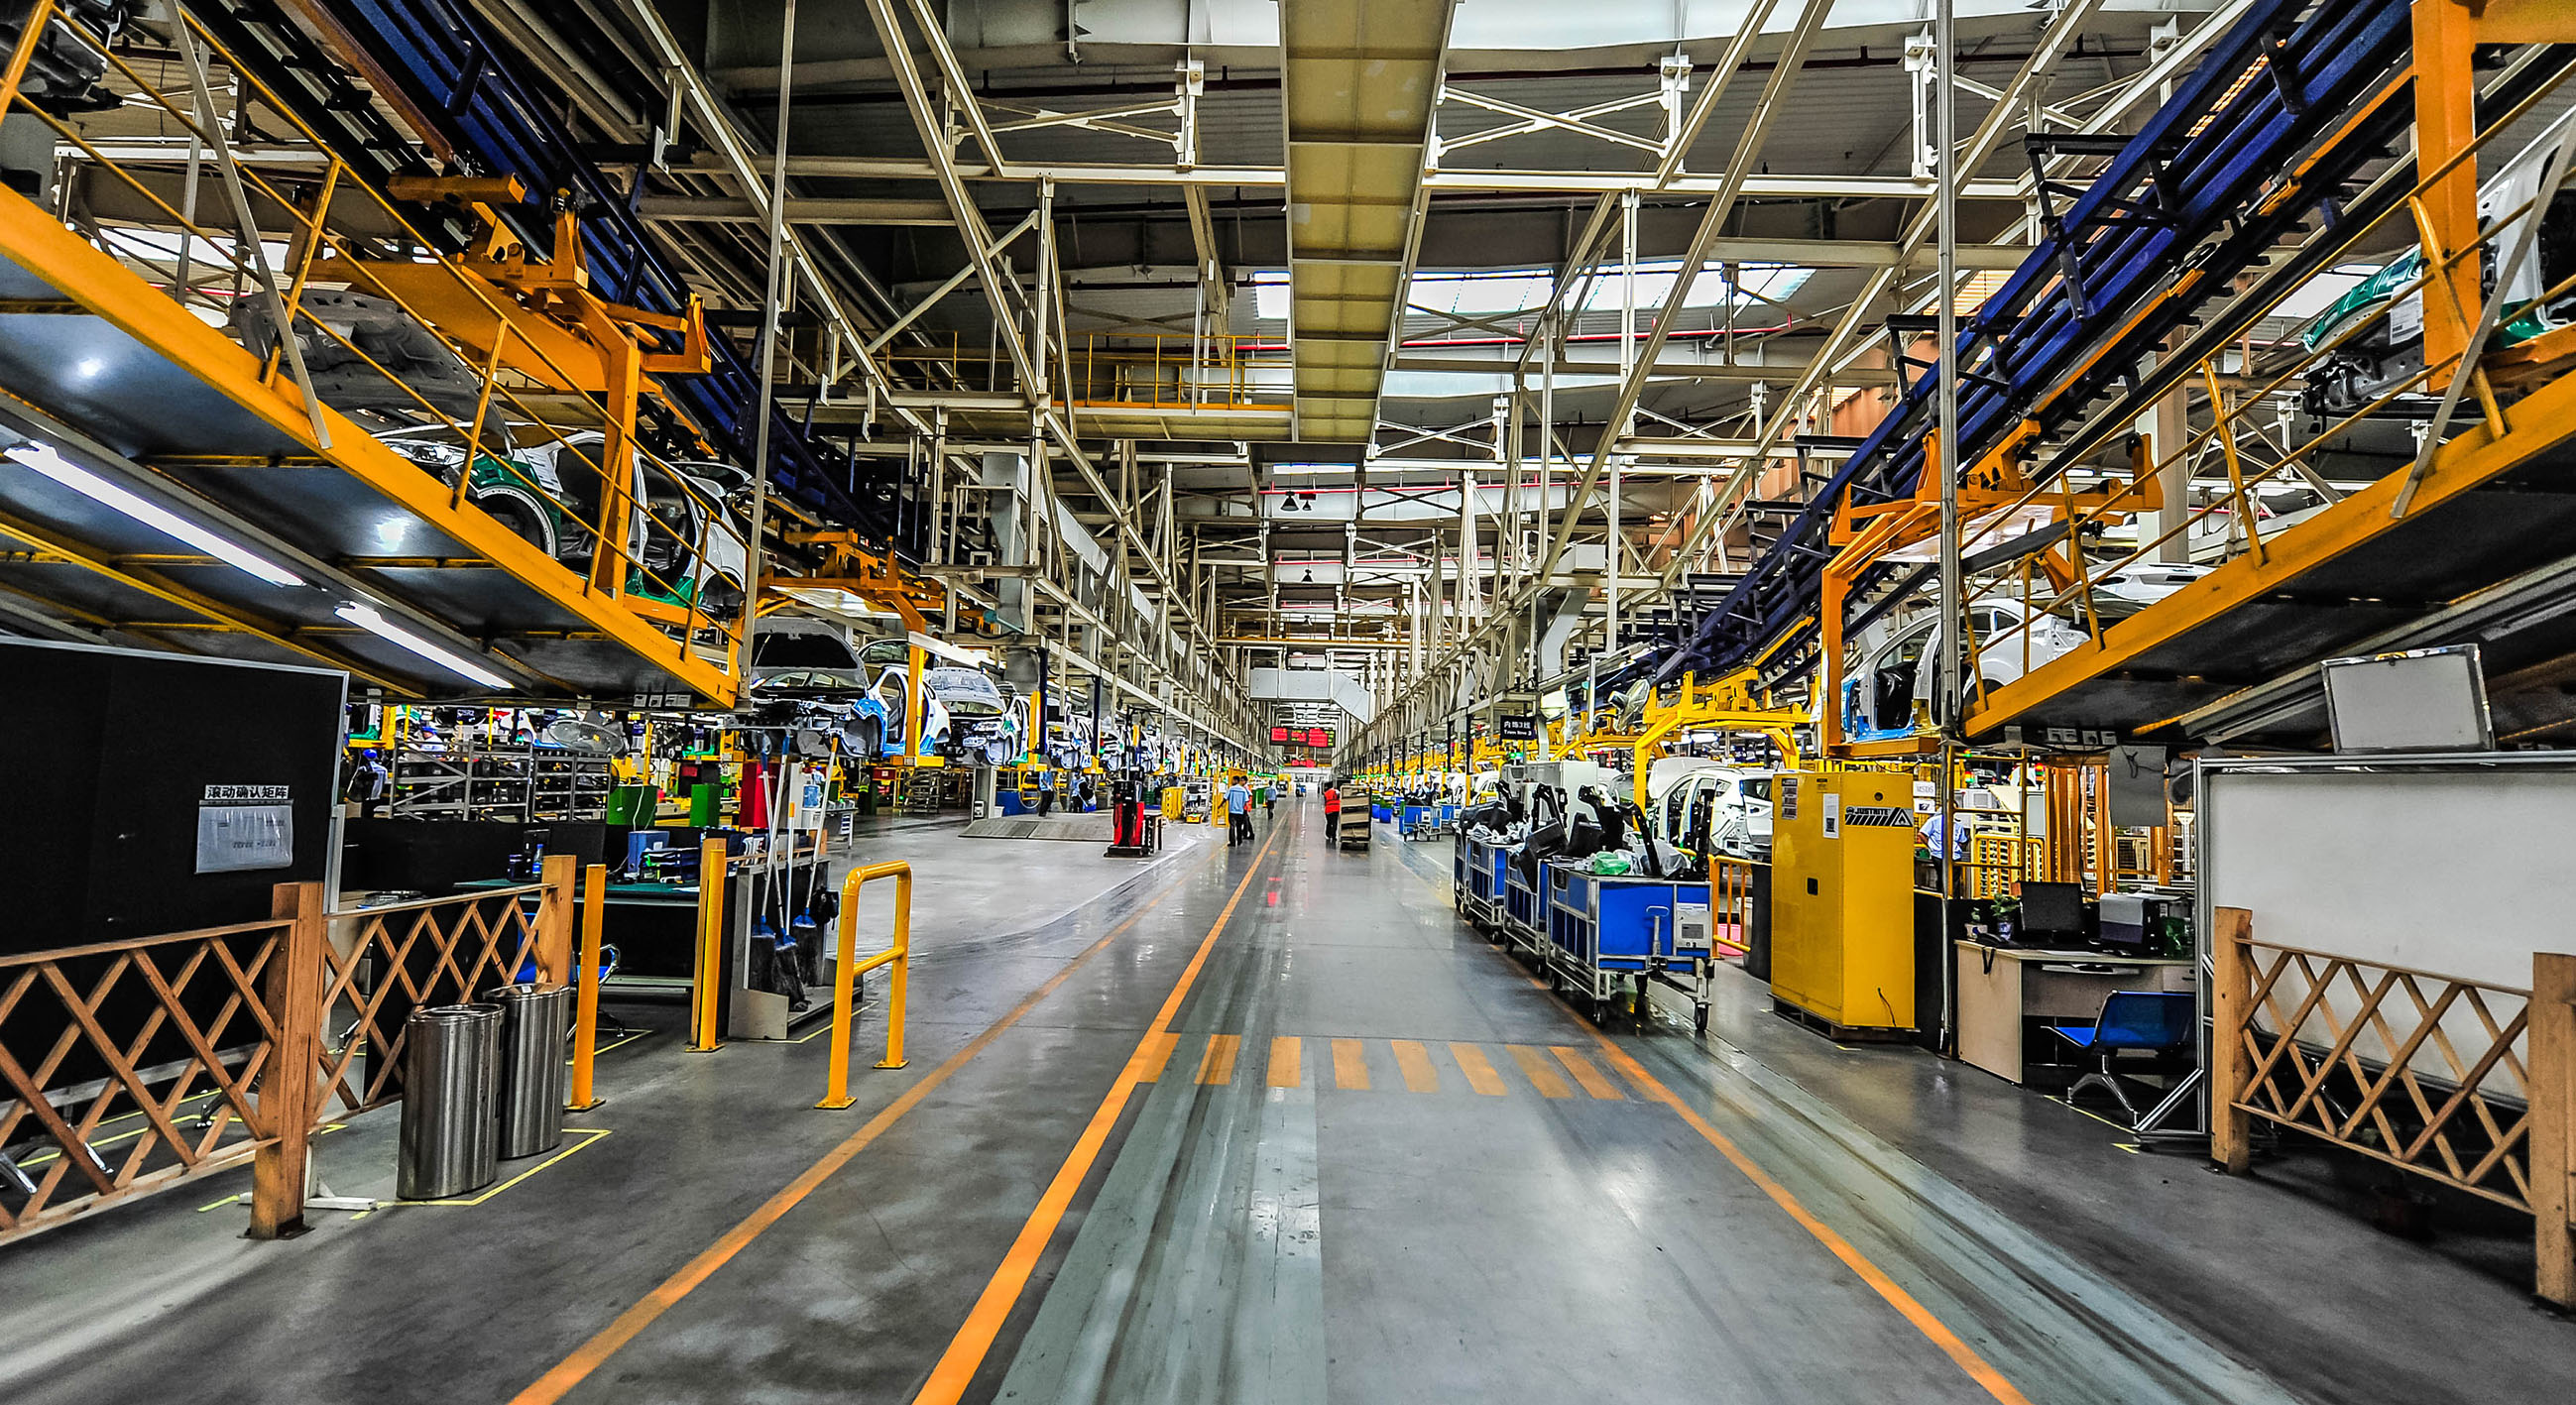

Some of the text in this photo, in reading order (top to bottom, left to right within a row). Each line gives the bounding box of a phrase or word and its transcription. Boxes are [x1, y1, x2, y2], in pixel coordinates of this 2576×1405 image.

[207, 786, 288, 798] 滚动确认矩阵
